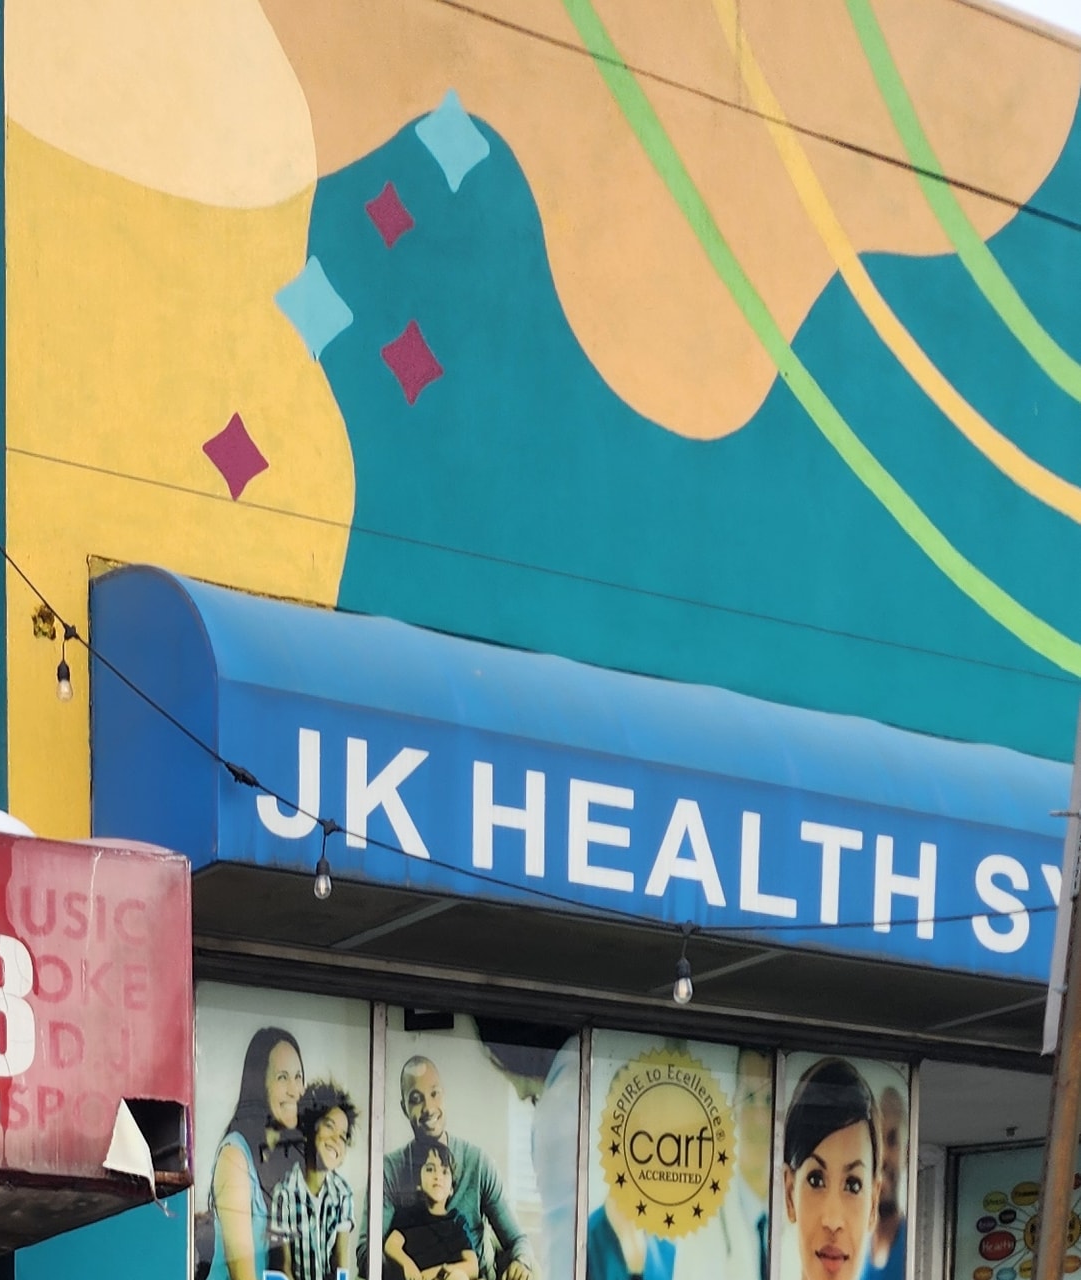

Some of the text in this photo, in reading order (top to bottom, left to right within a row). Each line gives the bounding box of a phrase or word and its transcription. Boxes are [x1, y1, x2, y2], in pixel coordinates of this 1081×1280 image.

[256, 727, 430, 860] JK
[472, 760, 938, 940] HEALTH
[610, 1077, 645, 1137] ASPIRE
[646, 1067, 661, 1084] to
[629, 1127, 713, 1168] carf
[638, 1169, 702, 1185] ACCREDITED
